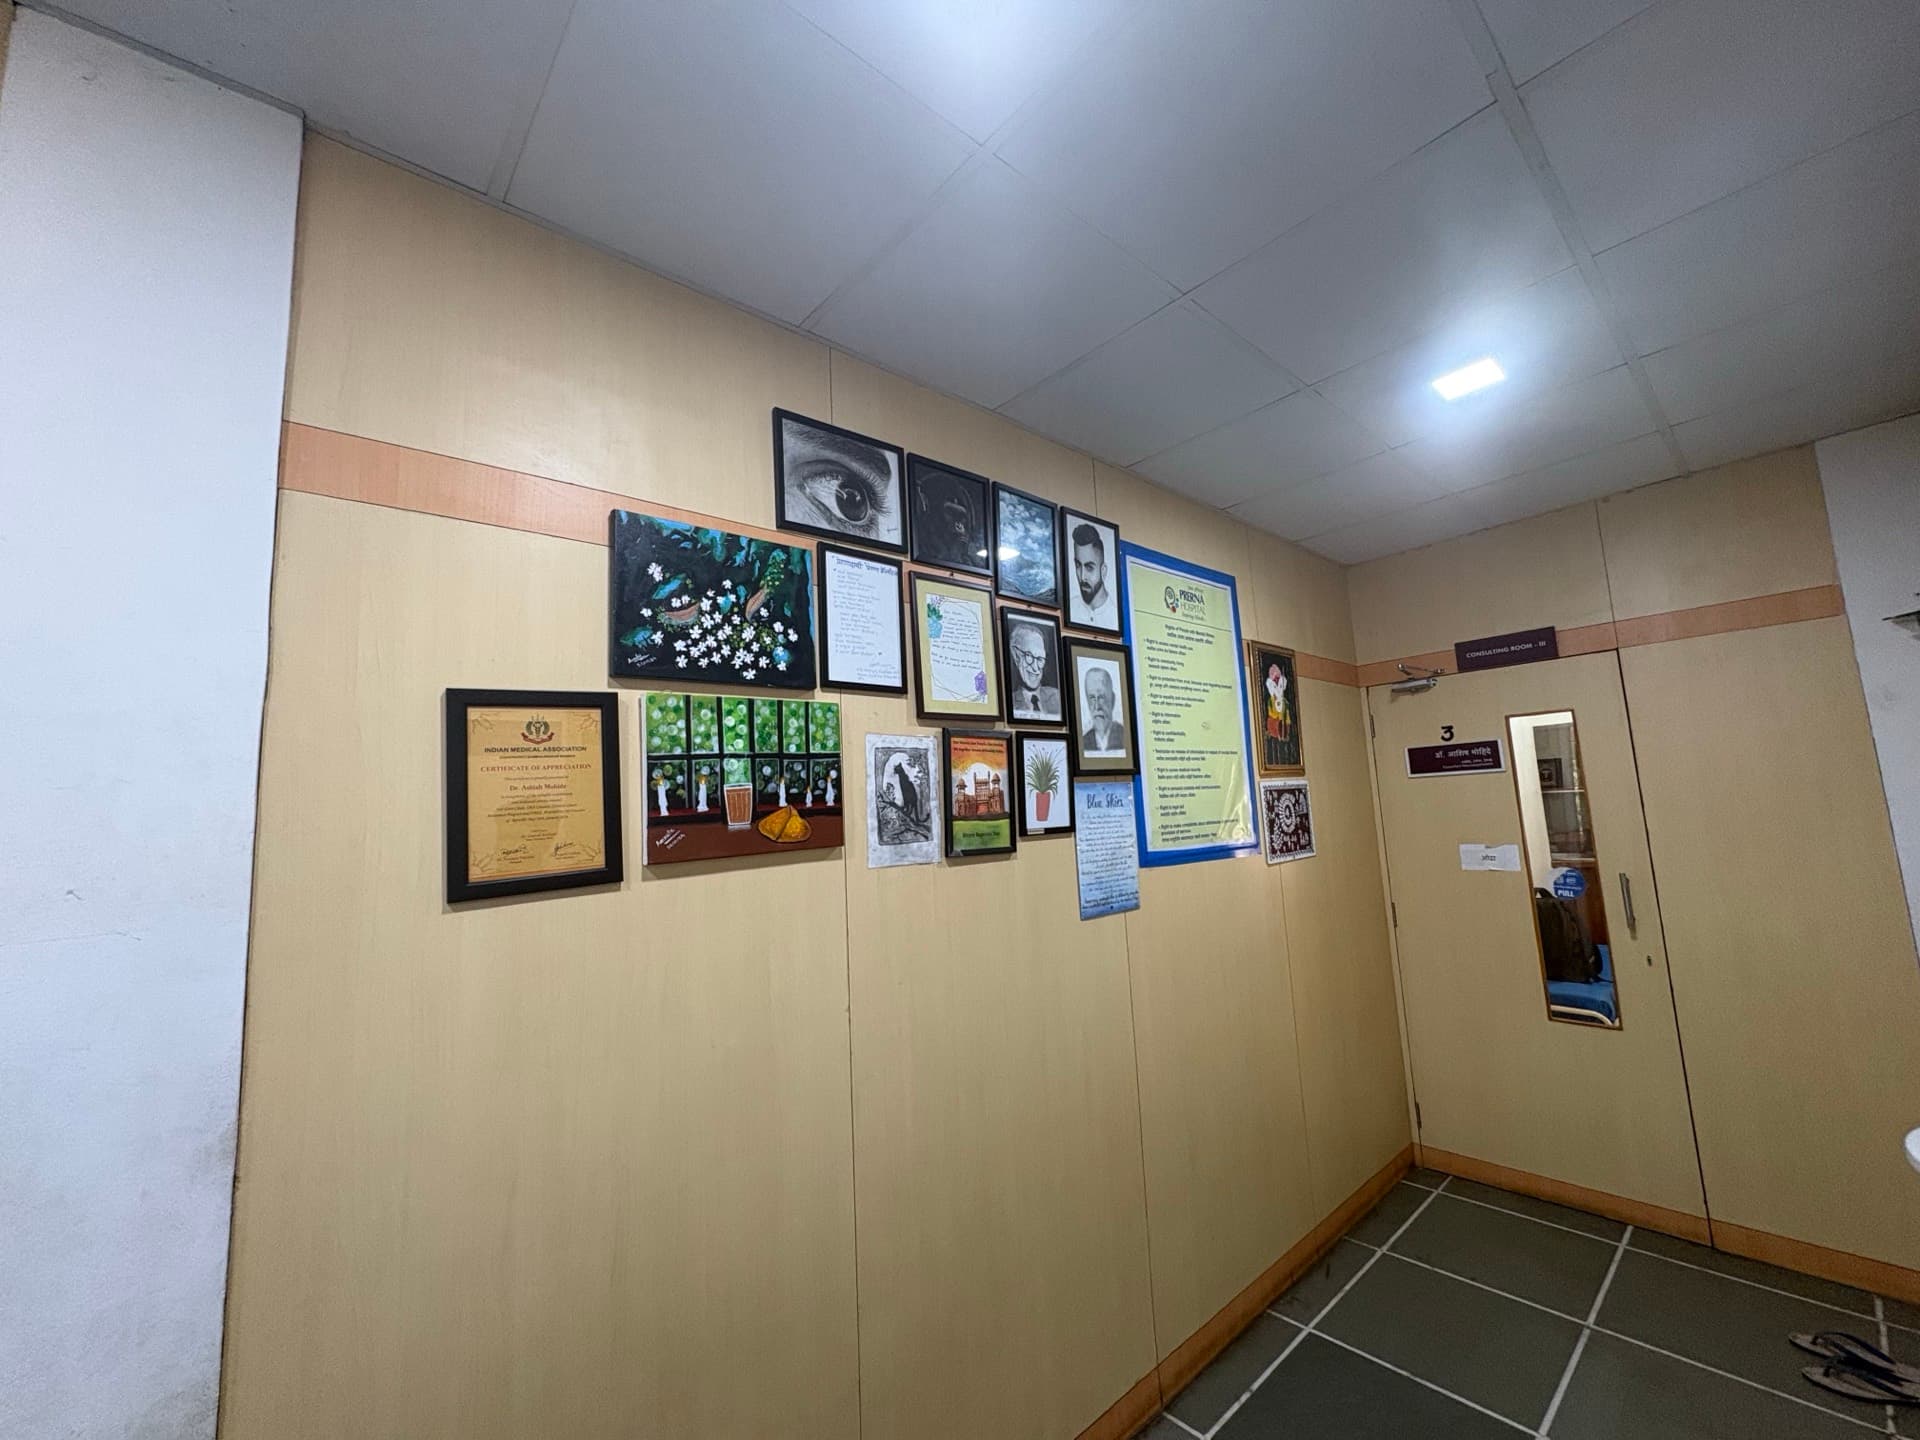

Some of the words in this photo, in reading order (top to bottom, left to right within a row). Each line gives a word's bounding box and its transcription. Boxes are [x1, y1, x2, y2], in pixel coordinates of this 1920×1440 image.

[1179, 589, 1205, 605] PRERNA
[1466, 646, 1509, 658] CONSULTING
[1510, 643, 1532, 651] ROOM
[1440, 725, 1454, 742] 3
[480, 764, 528, 772] CERTIFICATE
[1087, 794, 1103, 809] Blue
[1105, 793, 1124, 808] Skies
[1558, 890, 1575, 898] PULL
